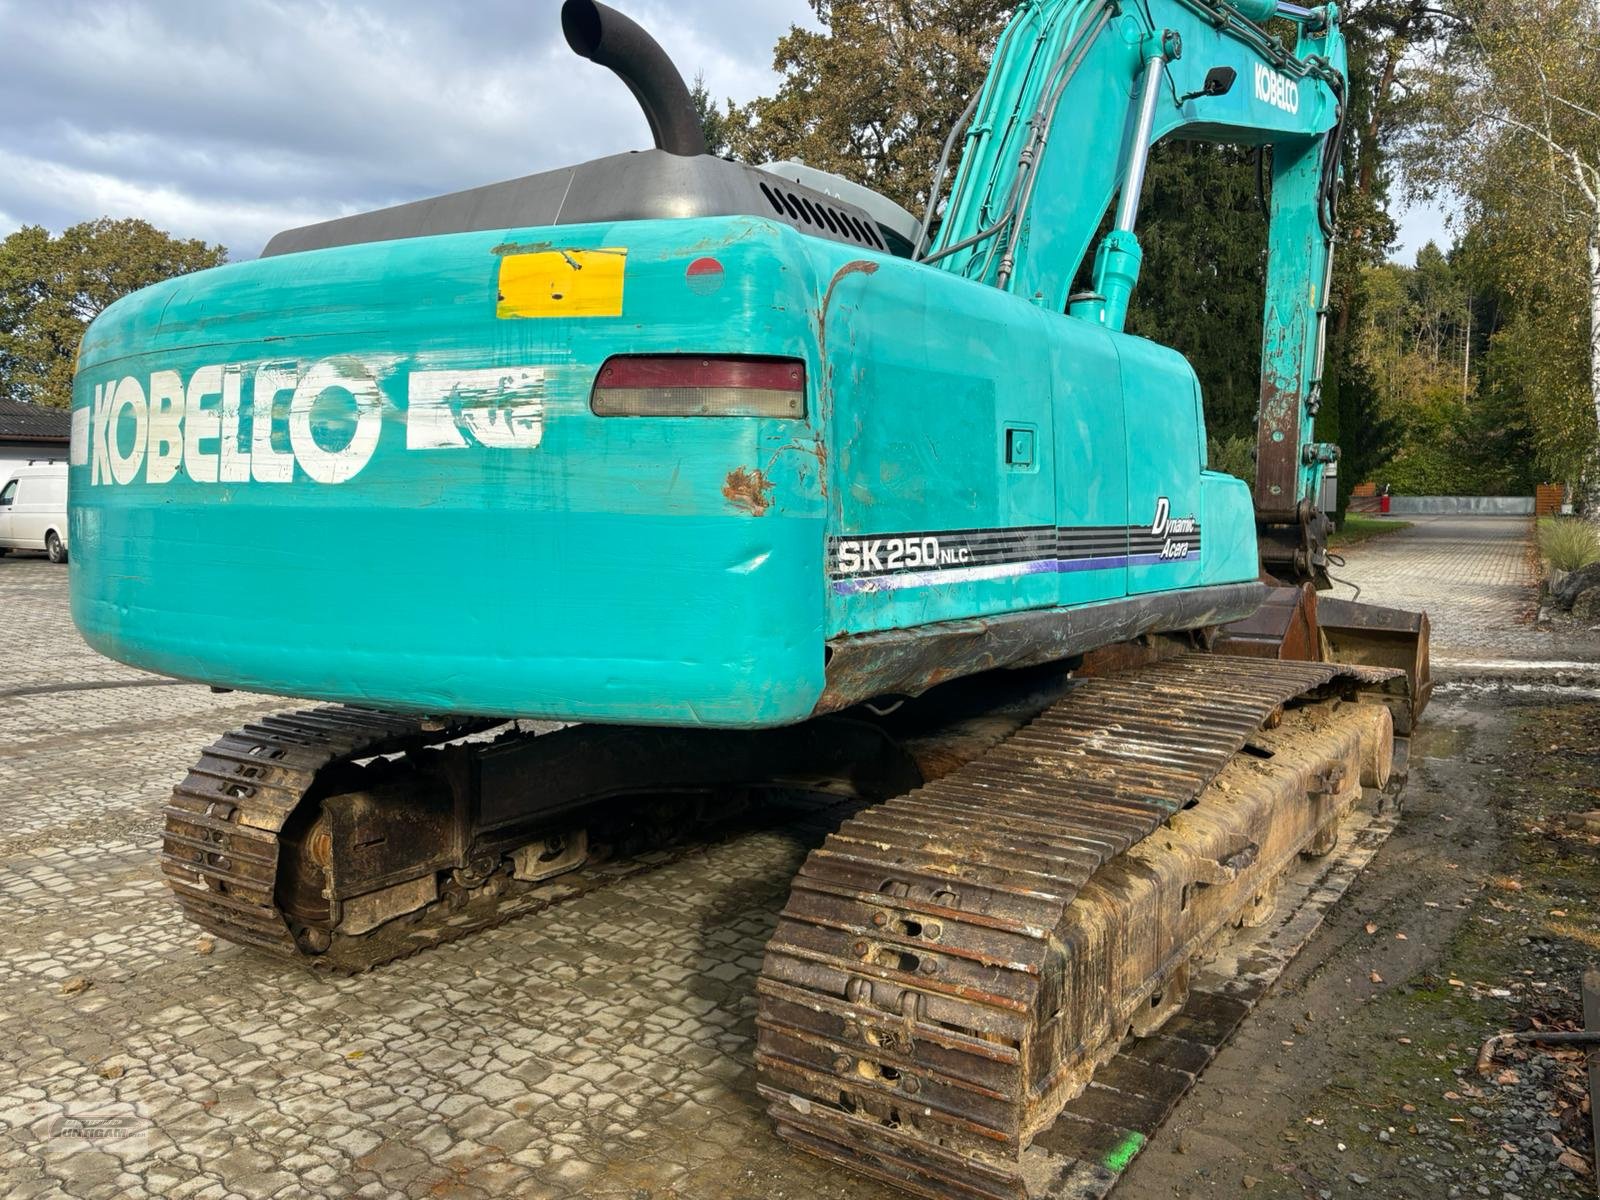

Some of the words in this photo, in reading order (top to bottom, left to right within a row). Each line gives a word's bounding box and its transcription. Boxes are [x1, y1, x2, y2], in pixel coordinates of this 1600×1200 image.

[1255, 62, 1299, 115] KOBELCO
[91, 354, 382, 485] KOBELCO
[1151, 497, 1195, 540] Dynamic
[1160, 538, 1189, 559] Acera
